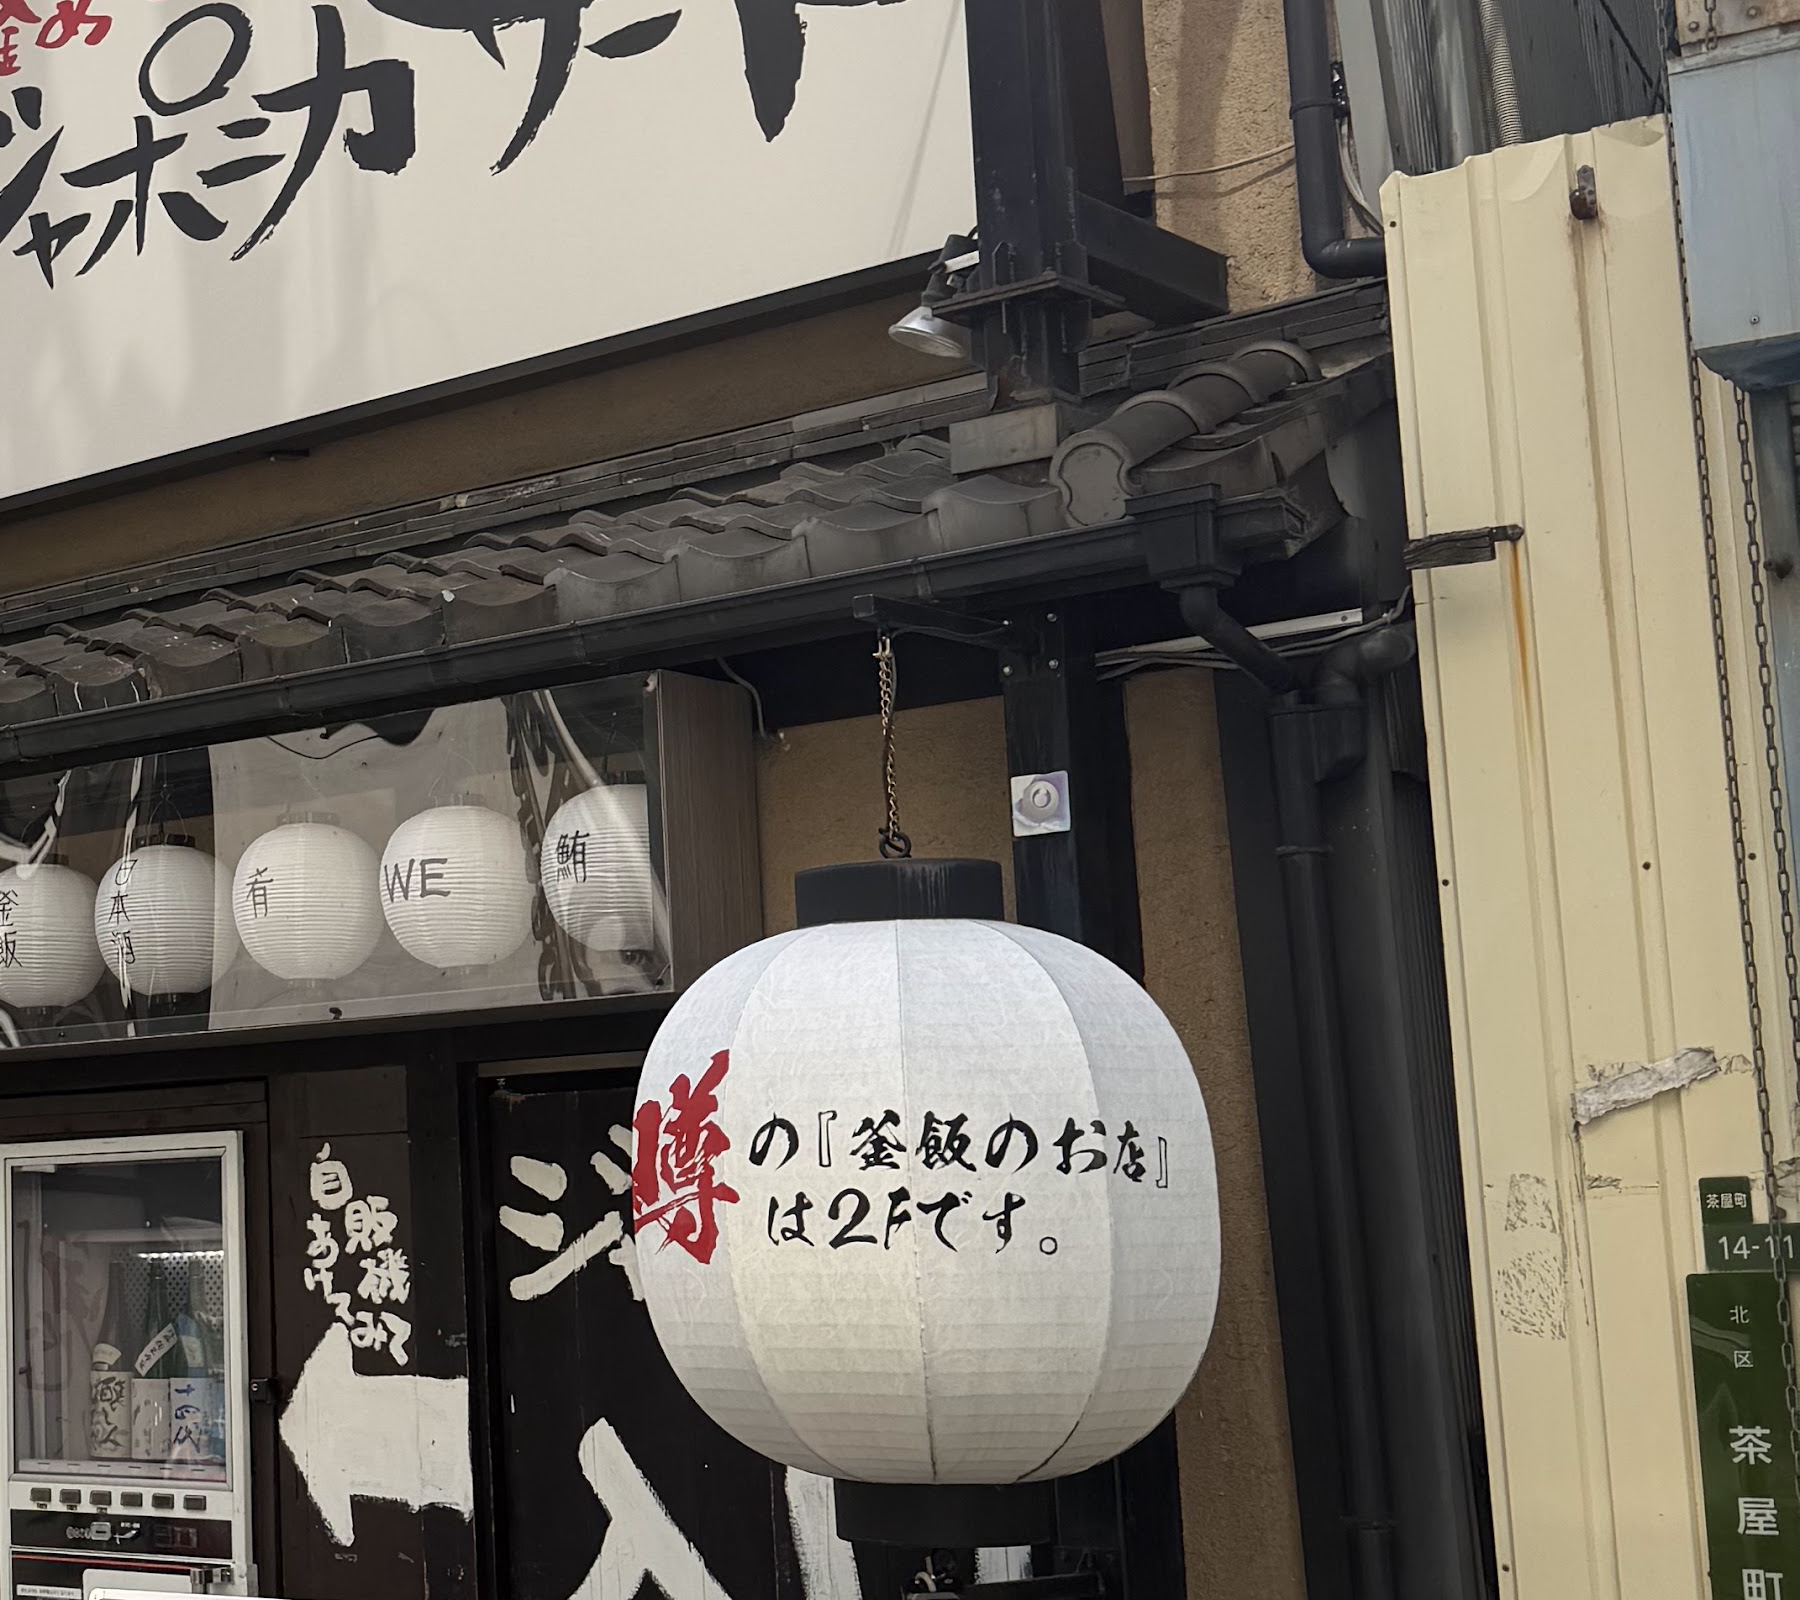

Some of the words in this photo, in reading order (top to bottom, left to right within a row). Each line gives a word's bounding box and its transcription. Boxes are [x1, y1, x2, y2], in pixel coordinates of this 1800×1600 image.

[105, 856, 137, 967] 日本酒
[382, 856, 451, 905] WE
[310, 1143, 412, 1306] 自販機
[768, 1187, 1059, 1256] は2Fです。
[1706, 1193, 1747, 1209] 茶屋町
[1718, 1235, 1794, 1260] 14-11
[1730, 1306, 1753, 1369] 北区
